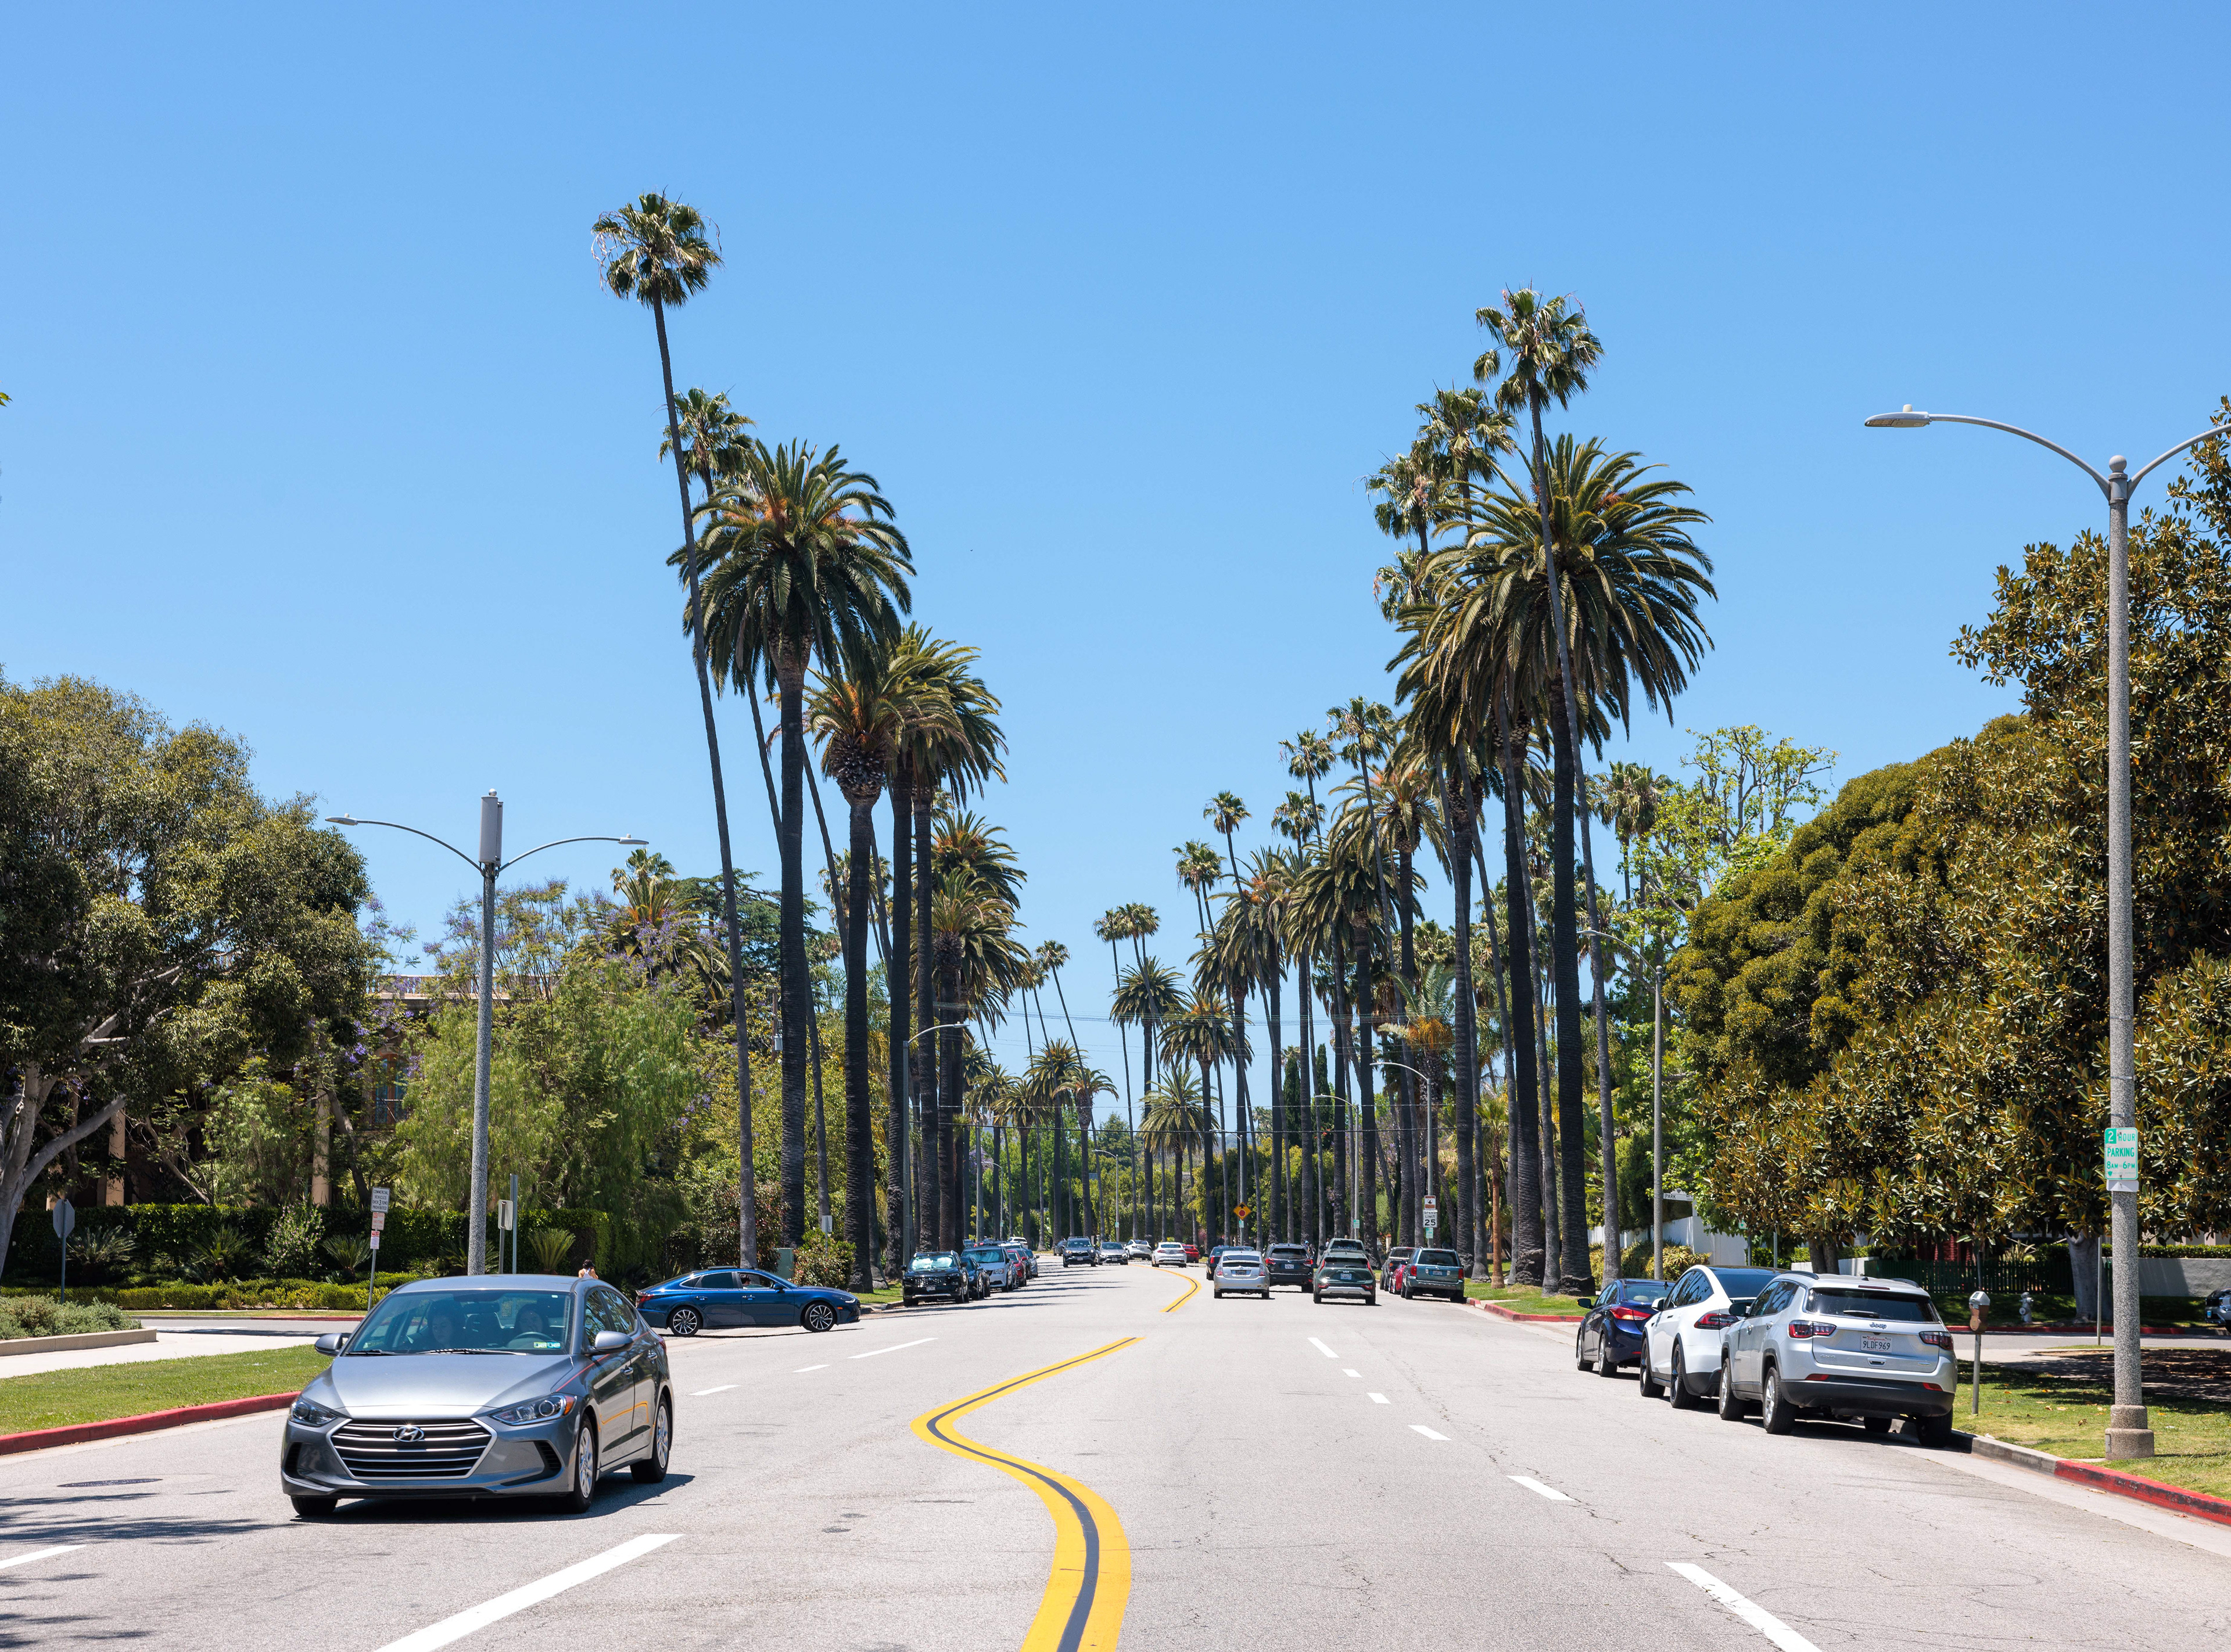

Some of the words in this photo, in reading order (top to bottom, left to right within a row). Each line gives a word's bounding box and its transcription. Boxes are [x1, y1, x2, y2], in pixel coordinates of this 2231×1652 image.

[2108, 1131, 2114, 1141] 2
[2118, 1133, 2135, 1141] HOUR
[2107, 1147, 2134, 1157] PARKING
[1863, 1341, 1891, 1351] 9LDF969
